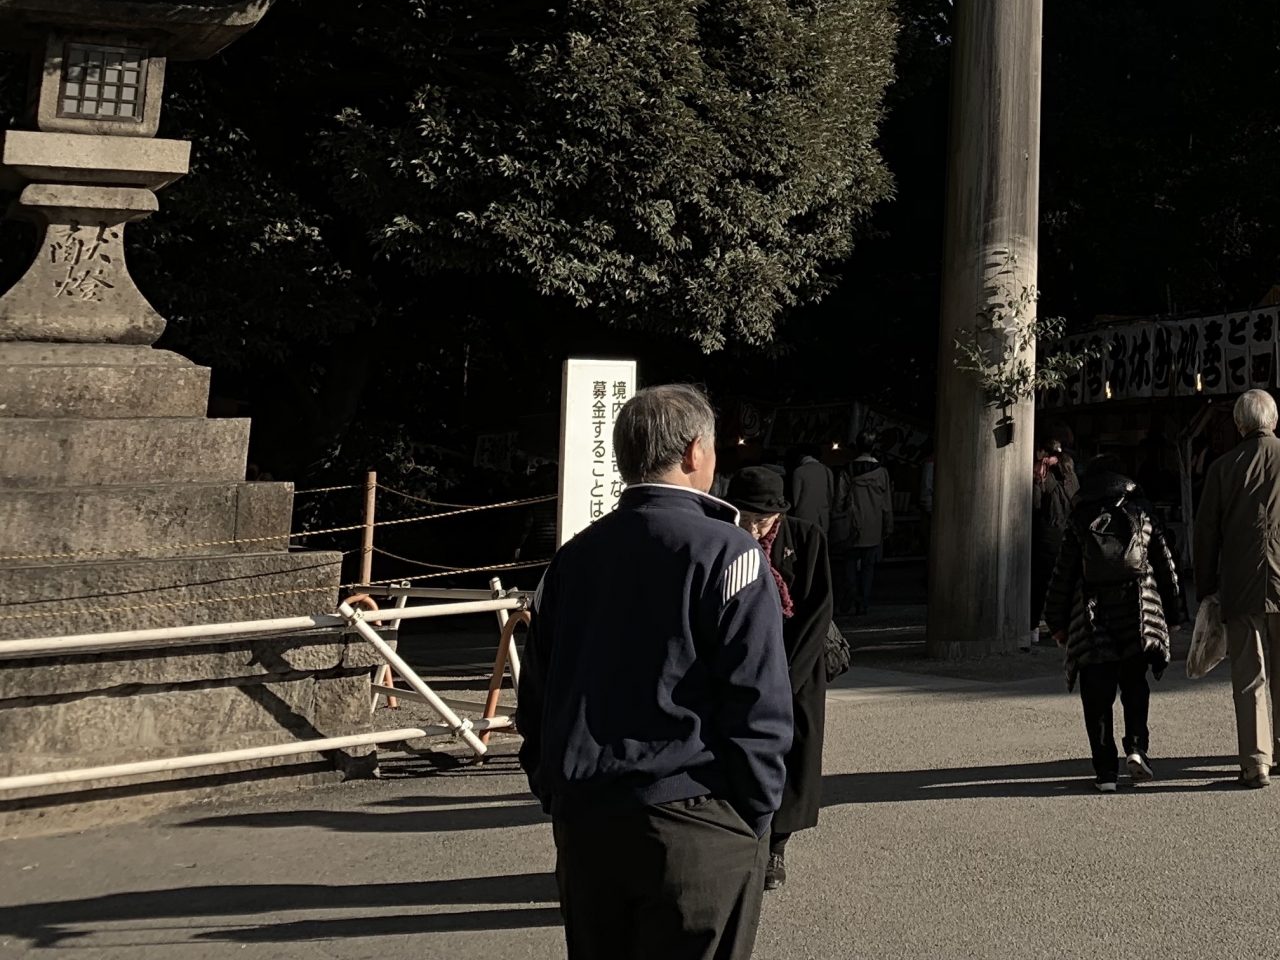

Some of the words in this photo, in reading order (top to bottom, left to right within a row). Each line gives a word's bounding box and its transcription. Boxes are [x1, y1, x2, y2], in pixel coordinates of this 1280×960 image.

[590, 381, 607, 524] 募金することは
